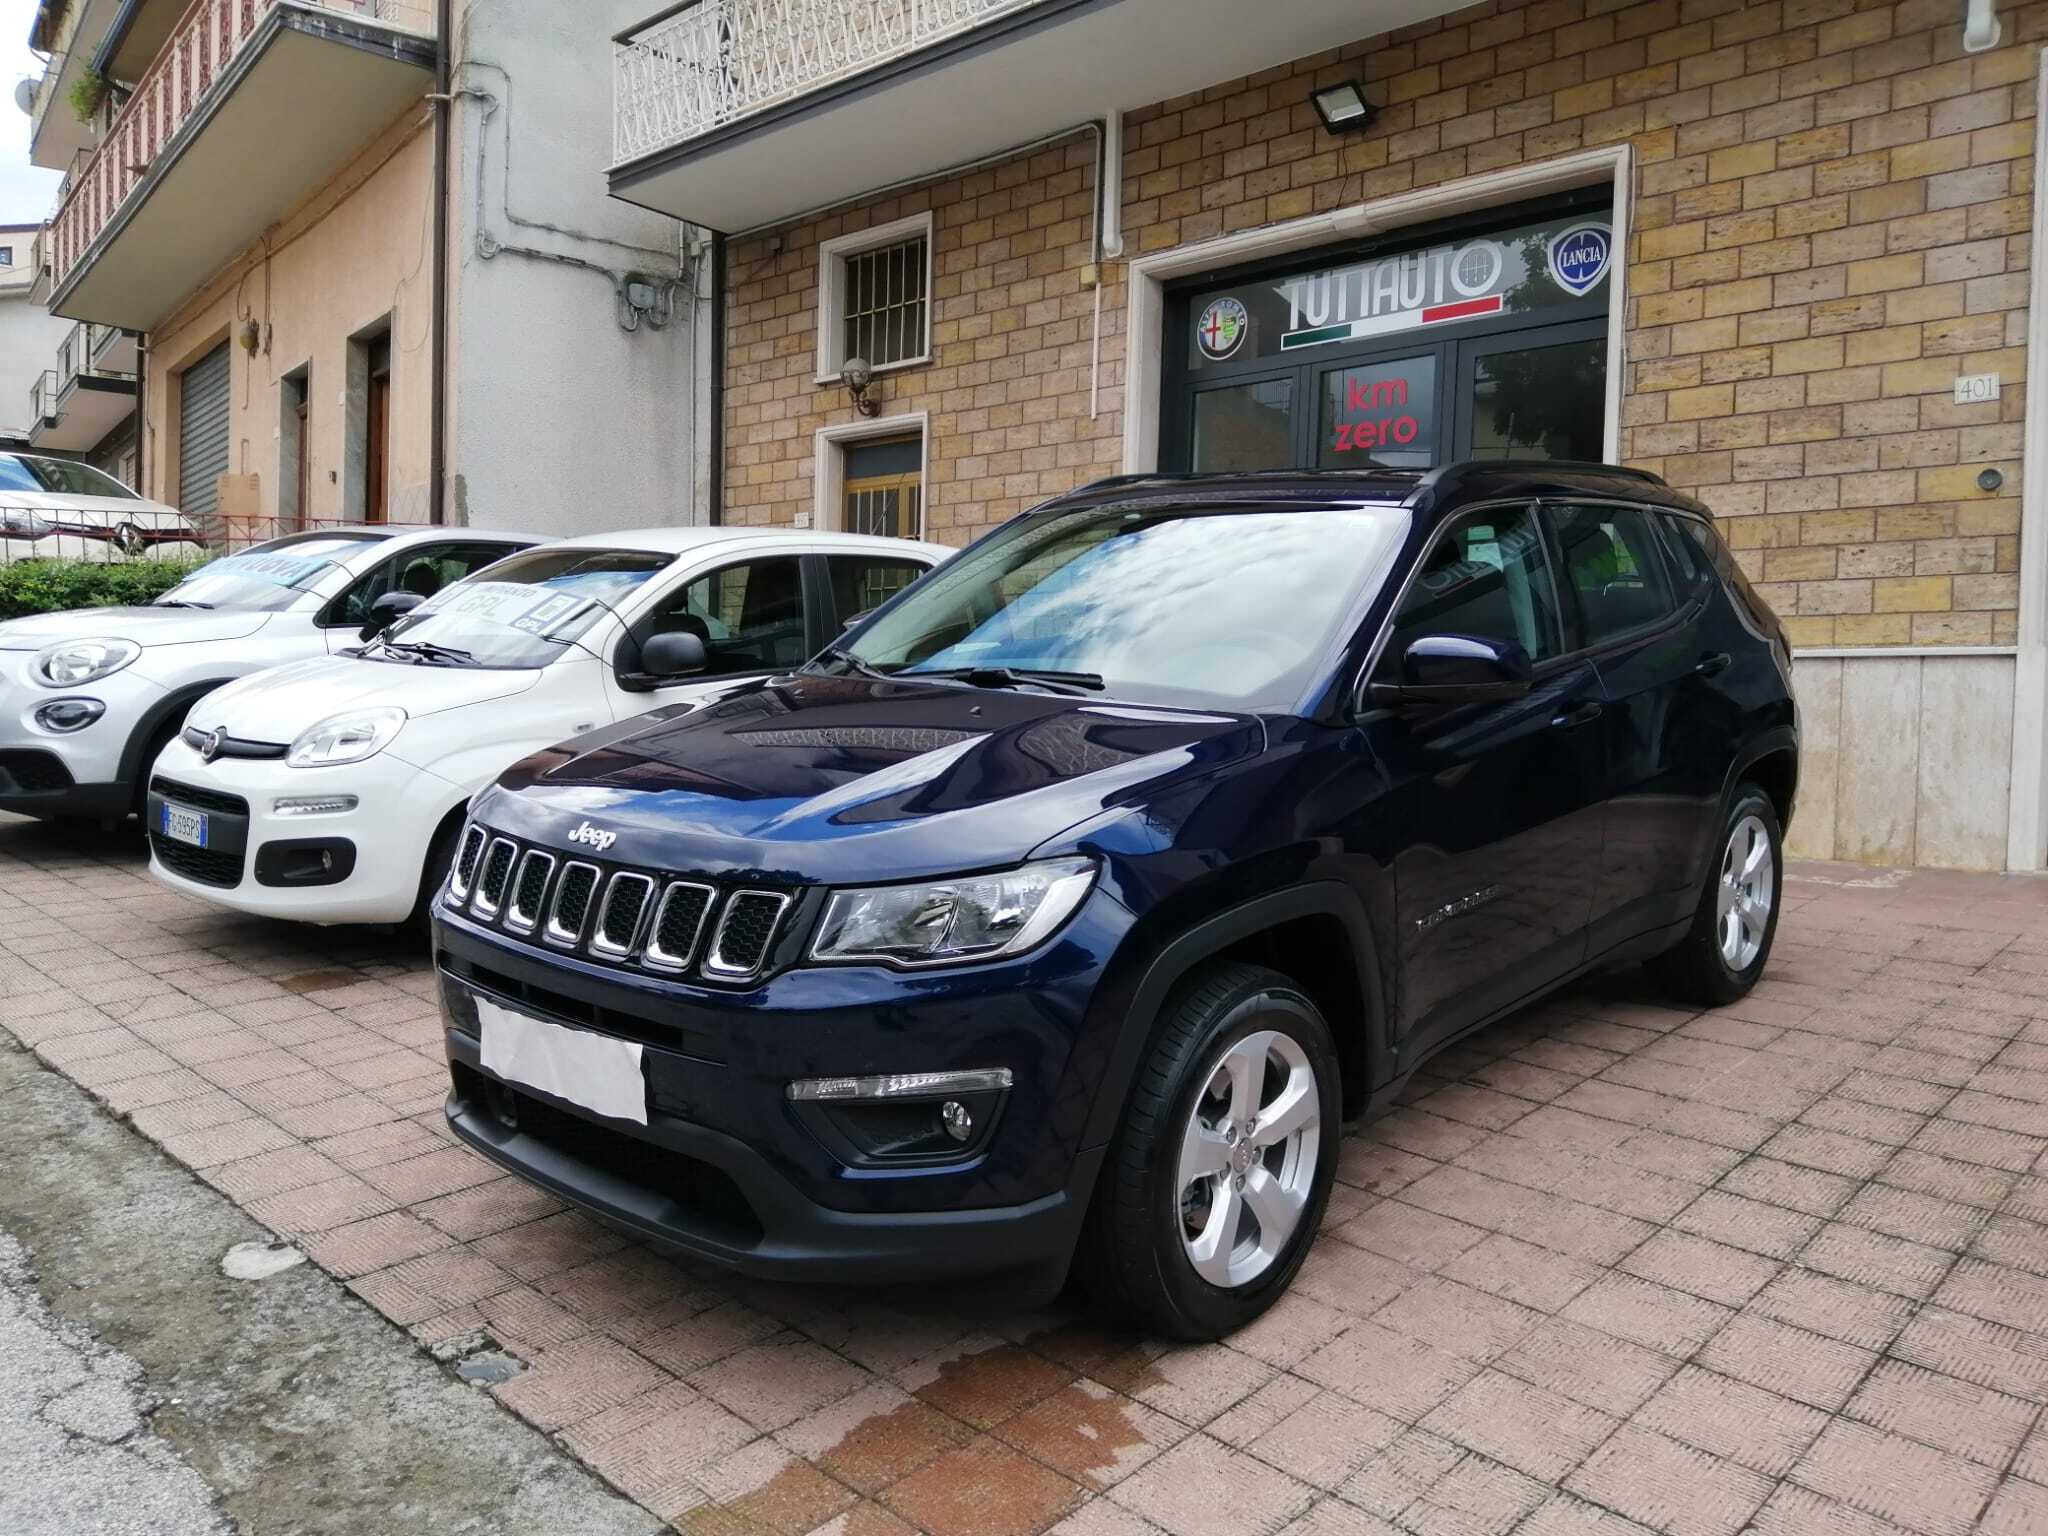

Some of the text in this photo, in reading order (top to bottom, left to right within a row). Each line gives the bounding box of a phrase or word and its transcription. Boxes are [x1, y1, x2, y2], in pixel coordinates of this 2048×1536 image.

[1563, 246, 1601, 267] LANCIA
[1283, 239, 1502, 330] TUTTAUTO
[1348, 376, 1407, 411] km
[1960, 378, 1992, 399] 401
[1333, 415, 1418, 452] zero
[568, 821, 616, 851] Jeep
